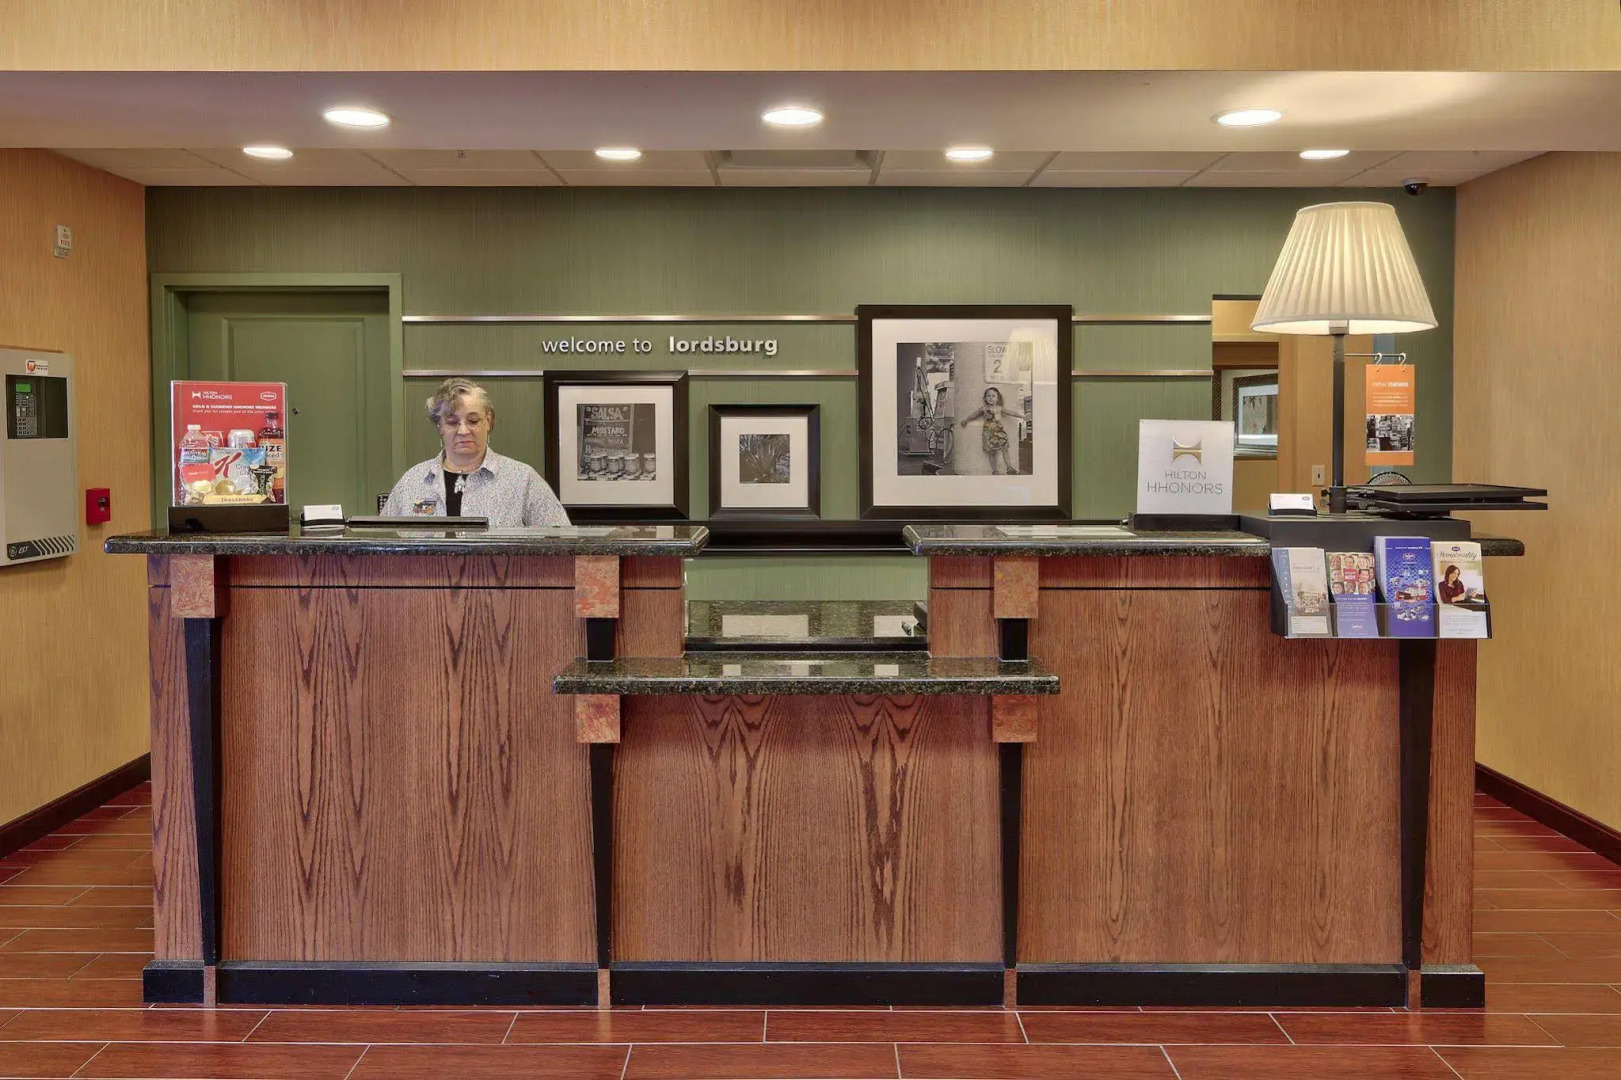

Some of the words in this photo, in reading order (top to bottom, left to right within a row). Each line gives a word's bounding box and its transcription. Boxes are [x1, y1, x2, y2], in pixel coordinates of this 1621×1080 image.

[542, 336, 626, 353] welcome
[632, 337, 653, 353] to
[669, 335, 778, 356] lordsburg
[1165, 470, 1207, 480] HILTON
[1147, 481, 1223, 495] HHONORS
